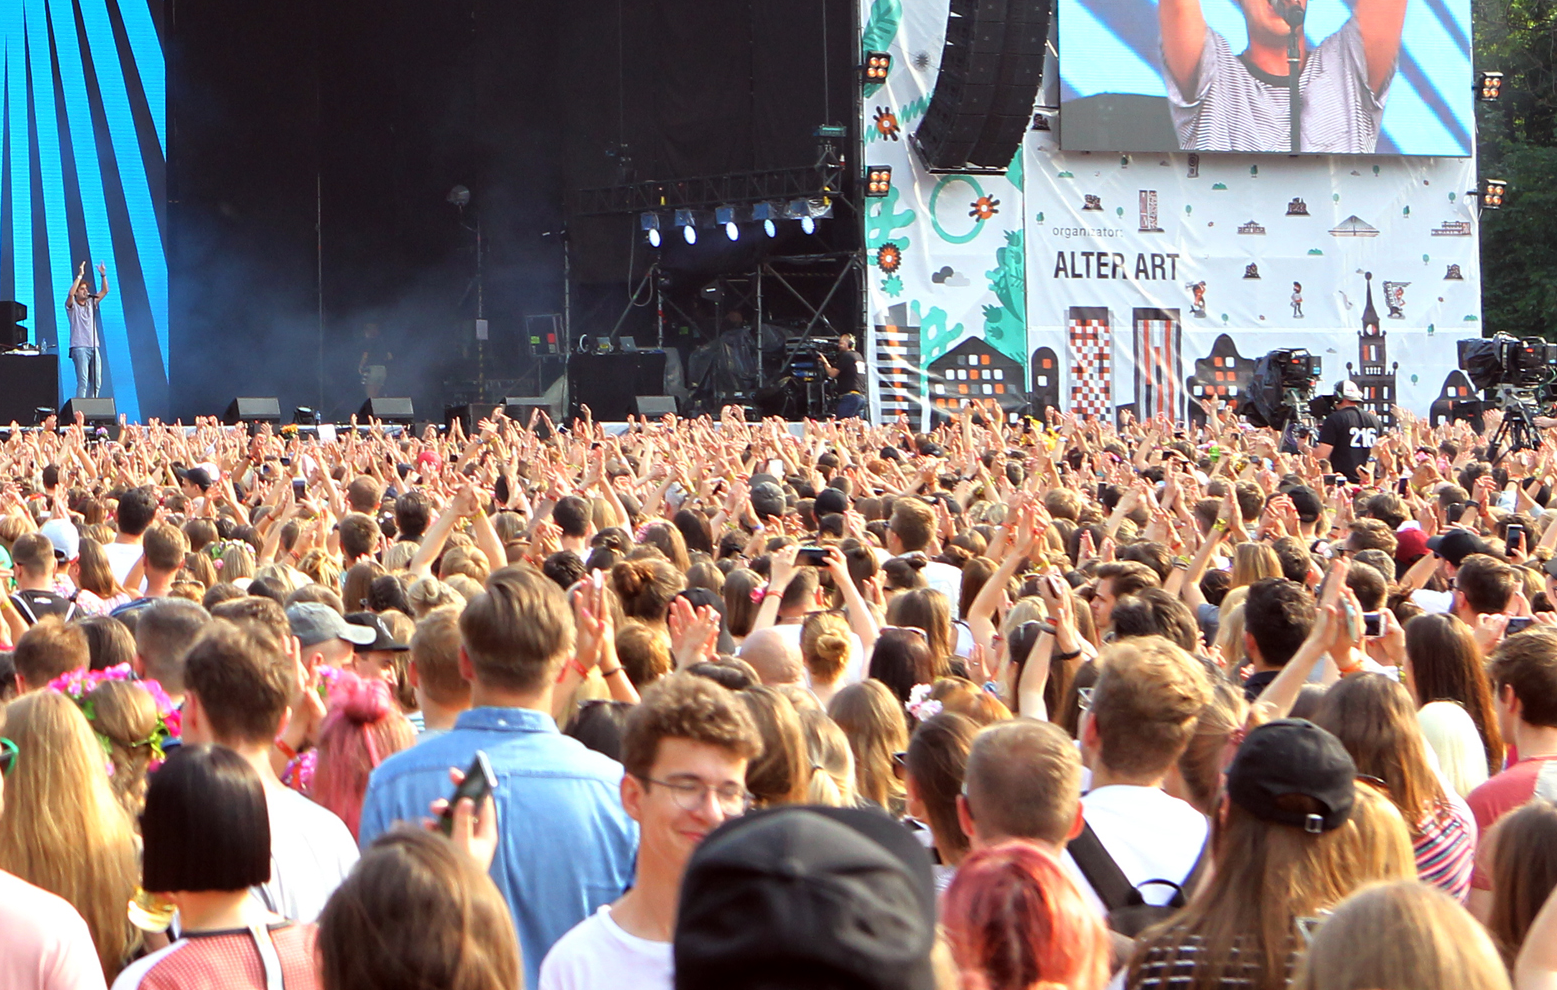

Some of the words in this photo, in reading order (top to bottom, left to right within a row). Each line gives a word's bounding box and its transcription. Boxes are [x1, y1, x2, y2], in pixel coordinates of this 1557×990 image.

[1053, 251, 1128, 280] ALTER
[1135, 253, 1180, 280] ART
[1349, 427, 1377, 448] 216
